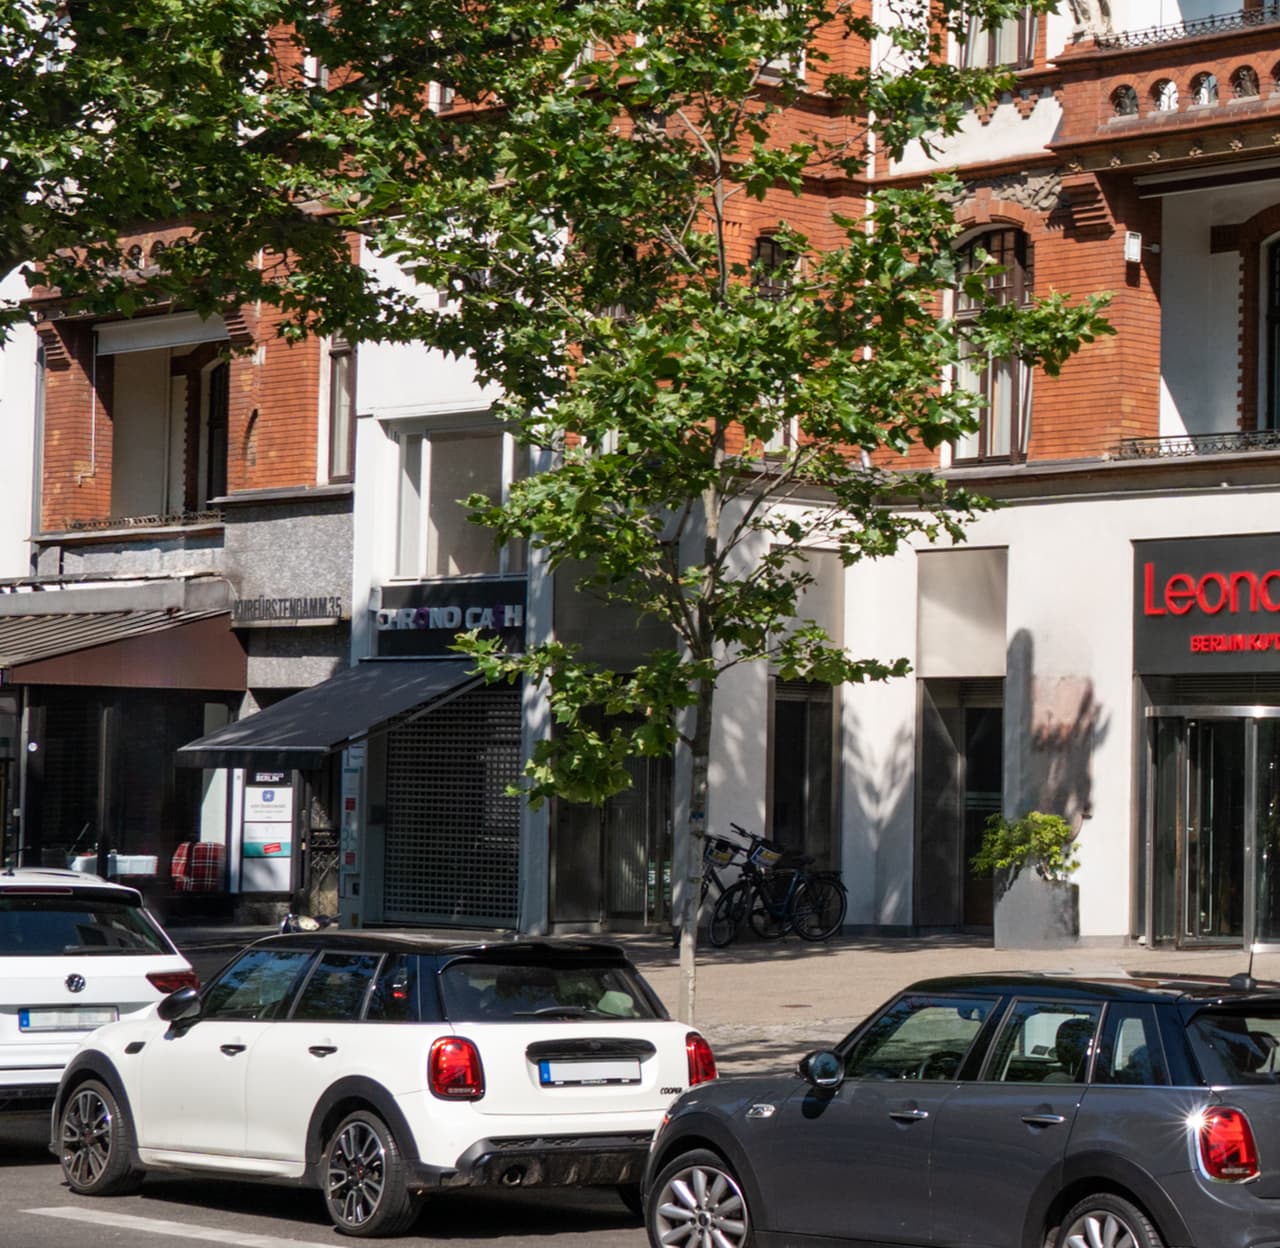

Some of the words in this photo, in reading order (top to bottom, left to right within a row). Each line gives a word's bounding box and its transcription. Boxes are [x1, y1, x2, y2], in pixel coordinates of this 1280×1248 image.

[328, 597, 342, 616] 35
[376, 606, 461, 630] CHRONO
[465, 603, 522, 631] CASH
[1190, 634, 1246, 652] BERLIN
